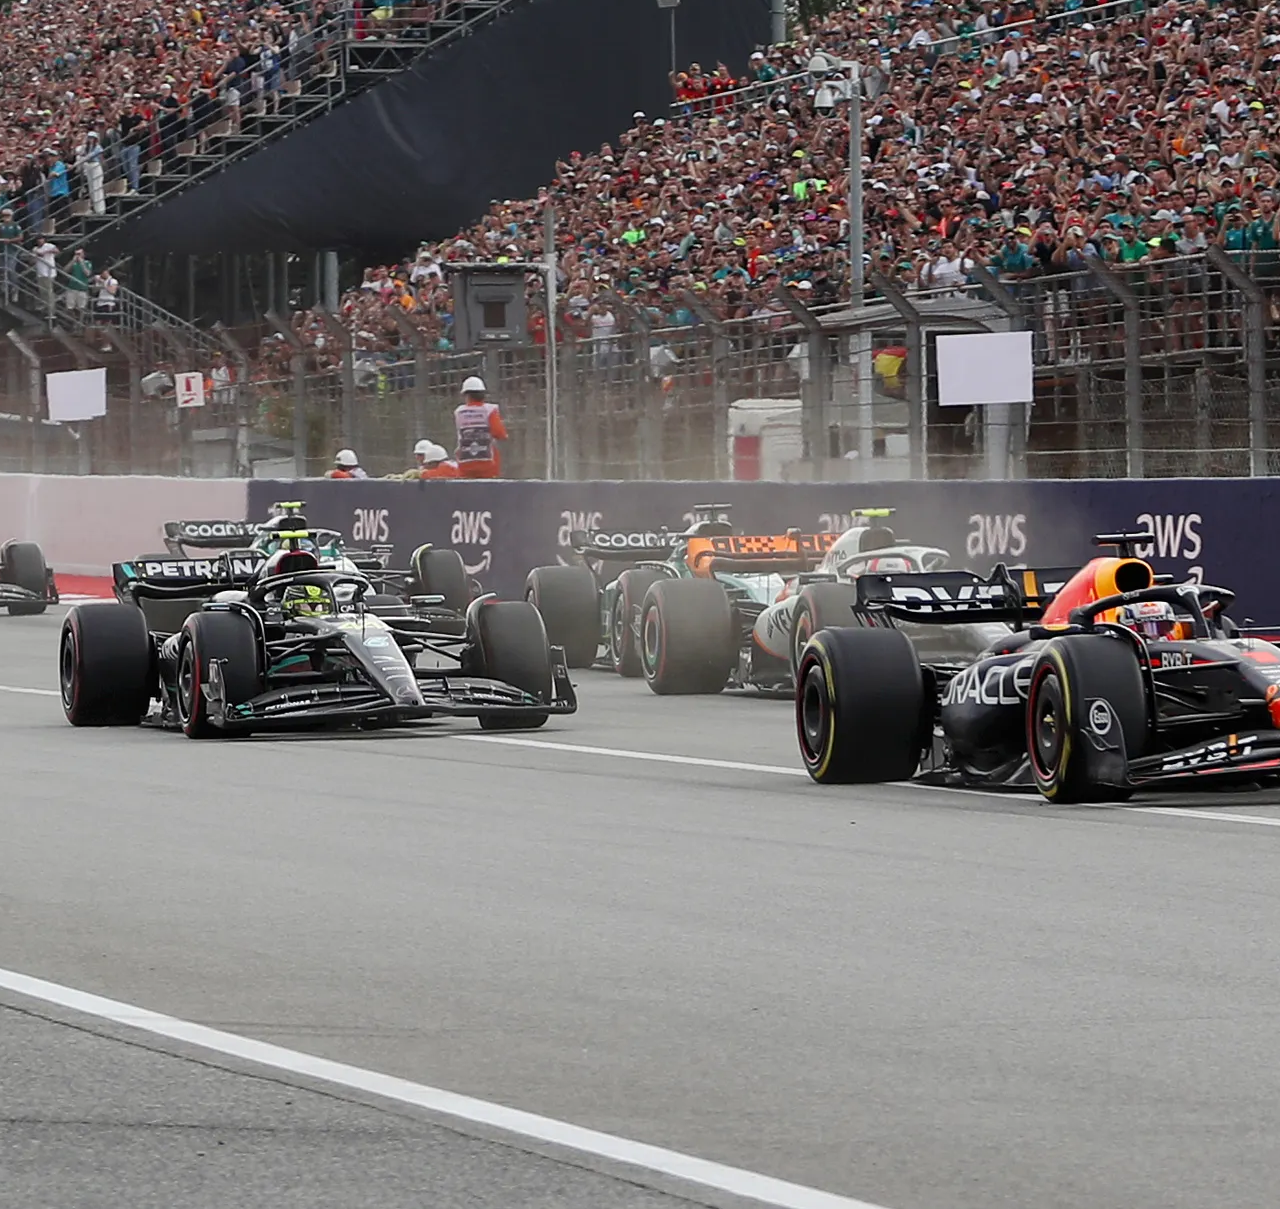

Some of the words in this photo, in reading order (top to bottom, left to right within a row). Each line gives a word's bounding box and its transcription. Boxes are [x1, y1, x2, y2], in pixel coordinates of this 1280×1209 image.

[353, 508, 389, 542] aws
[451, 510, 492, 545] aws
[966, 513, 1027, 557] aws
[1135, 513, 1202, 559] aws
